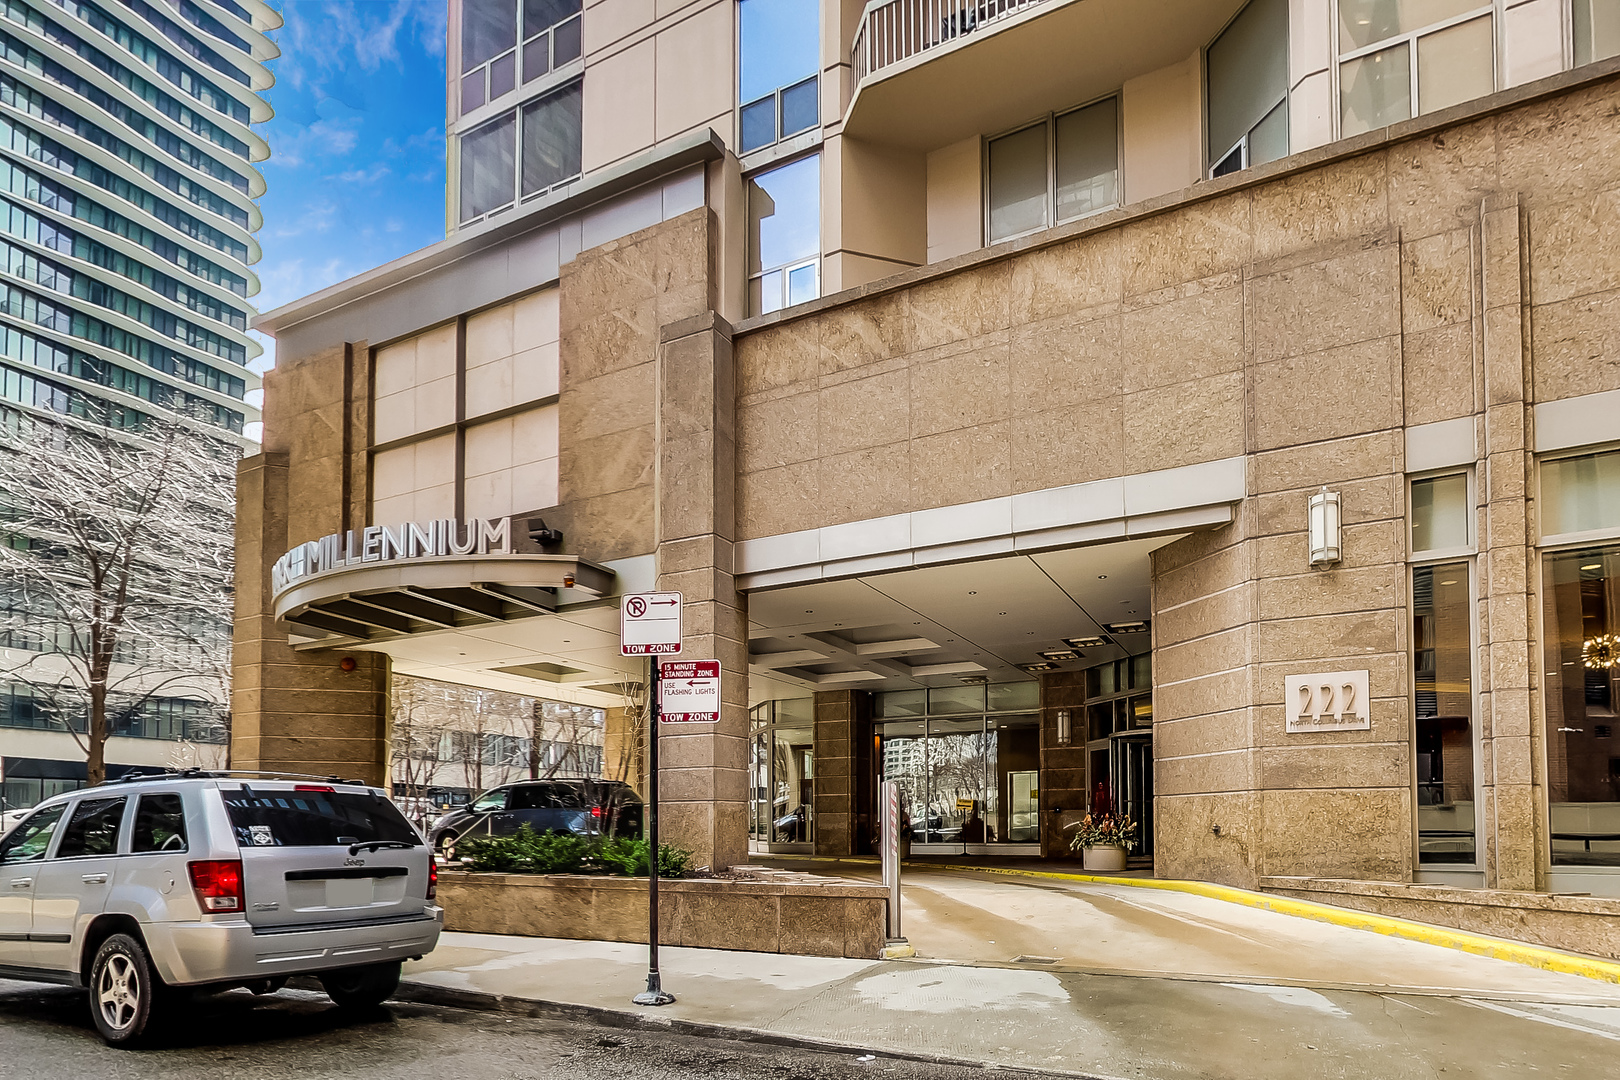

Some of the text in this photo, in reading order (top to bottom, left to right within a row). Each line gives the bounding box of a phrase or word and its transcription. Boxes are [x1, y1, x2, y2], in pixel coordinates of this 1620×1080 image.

[306, 516, 512, 577] MILLENNIUM
[626, 644, 676, 653] TOW ZONE
[664, 670, 694, 678] STANDING
[1298, 681, 1356, 717] 222
[664, 712, 714, 722] TOW ZONE
[343, 857, 365, 867] Jeep
